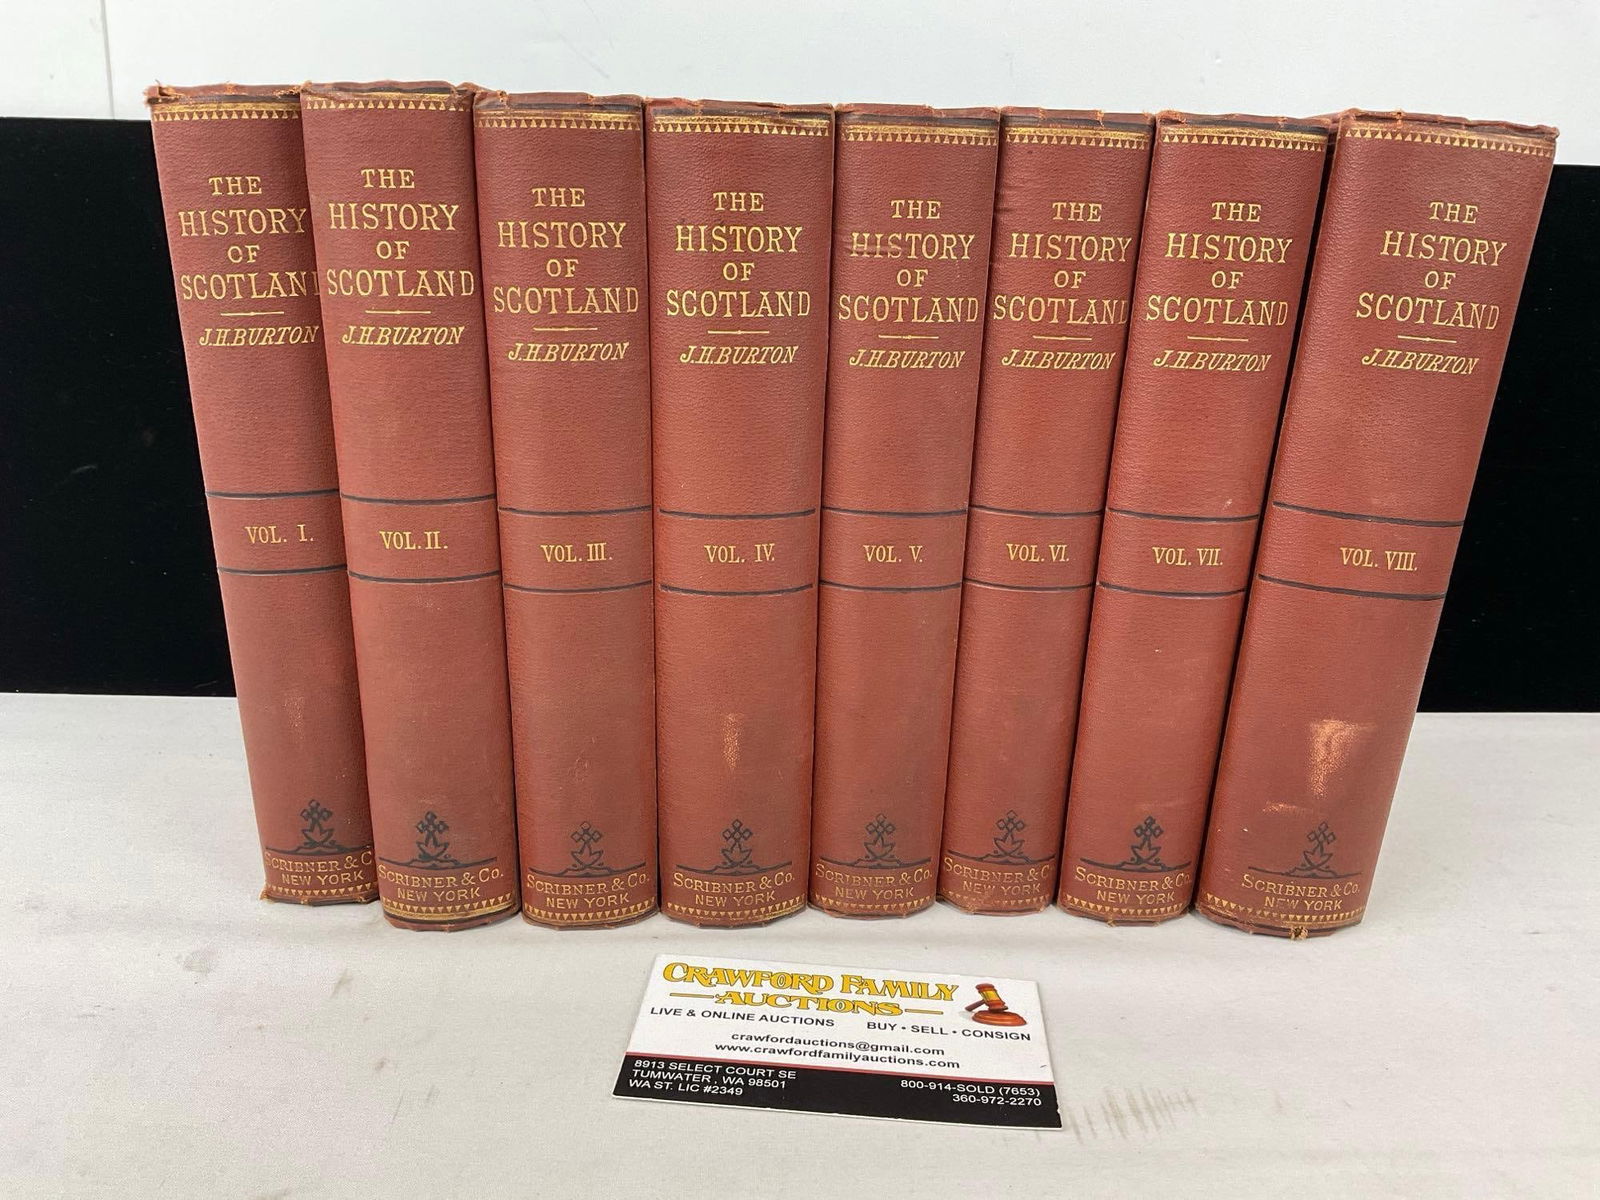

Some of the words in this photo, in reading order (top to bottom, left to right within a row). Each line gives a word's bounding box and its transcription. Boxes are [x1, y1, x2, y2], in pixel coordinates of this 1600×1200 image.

[208, 176, 262, 195] THE
[361, 168, 415, 189] THE
[532, 188, 586, 207] THE
[713, 192, 764, 212] THE
[329, 202, 459, 231] HISTORY
[890, 200, 941, 220] THE
[1052, 202, 1102, 222] THE
[1211, 201, 1262, 223] THE
[1429, 201, 1479, 225] THE
[179, 208, 307, 236] HISTORY
[497, 221, 627, 250] HISTORY
[675, 225, 803, 253] HISTORY
[227, 245, 260, 263] OF
[376, 240, 410, 260] OF
[849, 232, 975, 261] HISTORY
[1009, 233, 1132, 262] HISTORY
[1165, 232, 1293, 265] HISTORY
[1380, 230, 1507, 267] HISTORY
[546, 259, 579, 278] OF
[722, 262, 756, 282] OF
[896, 268, 929, 288] OF
[326, 269, 475, 298] SCOTLAND
[1054, 270, 1086, 289] OF
[1210, 270, 1244, 290] OF
[1424, 270, 1456, 291] OF
[493, 286, 639, 315] SCOTLAND
[666, 290, 810, 318] SCOTLAND
[838, 295, 979, 324] SCOTLAND
[993, 294, 1129, 325] SCOTLAND
[1146, 295, 1288, 327] SCOTLAND
[1355, 292, 1500, 331] SCOTLAND
[245, 525, 287, 545] VOL.
[704, 544, 745, 564] VOL.
[863, 544, 902, 564] VOL.
[344, 855, 359, 869] &
[943, 857, 1024, 883] SCRIBNER
[1027, 868, 1039, 882] &
[281, 873, 311, 886] NEW
[317, 870, 364, 885] YORK
[378, 864, 458, 888] SCRIBNER
[461, 872, 476, 886] &
[479, 867, 504, 883] Co.
[527, 874, 609, 895] SCRIBNER
[611, 878, 625, 892] &
[627, 873, 650, 888] Co.
[673, 872, 756, 894] SCRIBNER
[759, 876, 772, 890] &
[774, 872, 795, 886] Co.
[815, 863, 896, 887] SCRIBNER
[899, 872, 912, 886] &
[914, 868, 933, 883] Co.
[1075, 866, 1159, 891] SCRIBNER
[1161, 876, 1174, 890] &
[397, 887, 427, 902] NEW
[433, 887, 480, 902] YORK
[835, 887, 867, 900] NEW
[872, 887, 914, 900] YORK
[963, 881, 996, 895] NEW
[1001, 883, 1041, 896] YORK
[1241, 874, 1328, 898] SCRIBNER
[1330, 884, 1342, 897] &
[1343, 882, 1360, 896] Co.
[546, 897, 579, 909] NEW
[584, 892, 630, 909] YORK
[695, 894, 727, 907] NEW
[733, 890, 776, 907] YORK
[1096, 890, 1130, 904] NEW
[1136, 892, 1175, 905] YORK
[1304, 900, 1343, 911] YORK
[662, 961, 834, 994] CRAWFORD
[840, 974, 960, 1002] FAMILY
[714, 990, 903, 1016] AUCTIONS
[650, 1007, 682, 1017] LIVE
[686, 1009, 696, 1018] &
[701, 1010, 755, 1021] ONLINE
[758, 1014, 835, 1027] AUCTIONS
[867, 1021, 897, 1031] BUY
[911, 1025, 949, 1036] SELL
[961, 1029, 1031, 1041] CONSIGN
[731, 1032, 945, 1056] crawfordauctions@gmail.com
[715, 1043, 960, 1069] www.crawfordfamilyauctions.com
[634, 1059, 665, 1069] 8913
[668, 1062, 722, 1074] SELECT
[725, 1067, 774, 1078] COURT
[778, 1070, 797, 1079] SE
[628, 1078, 651, 1088] WA
[654, 1081, 673, 1090] ST.
[678, 1083, 700, 1093] LIC
[703, 1085, 743, 1096] #2349
[722, 1076, 745, 1086] WA
[748, 1078, 786, 1089] 98501
[900, 1079, 995, 1095] 800-914-SOLD
[998, 1086, 1040, 1098] (7653)
[952, 1093, 1042, 1107] 360-972-2270
